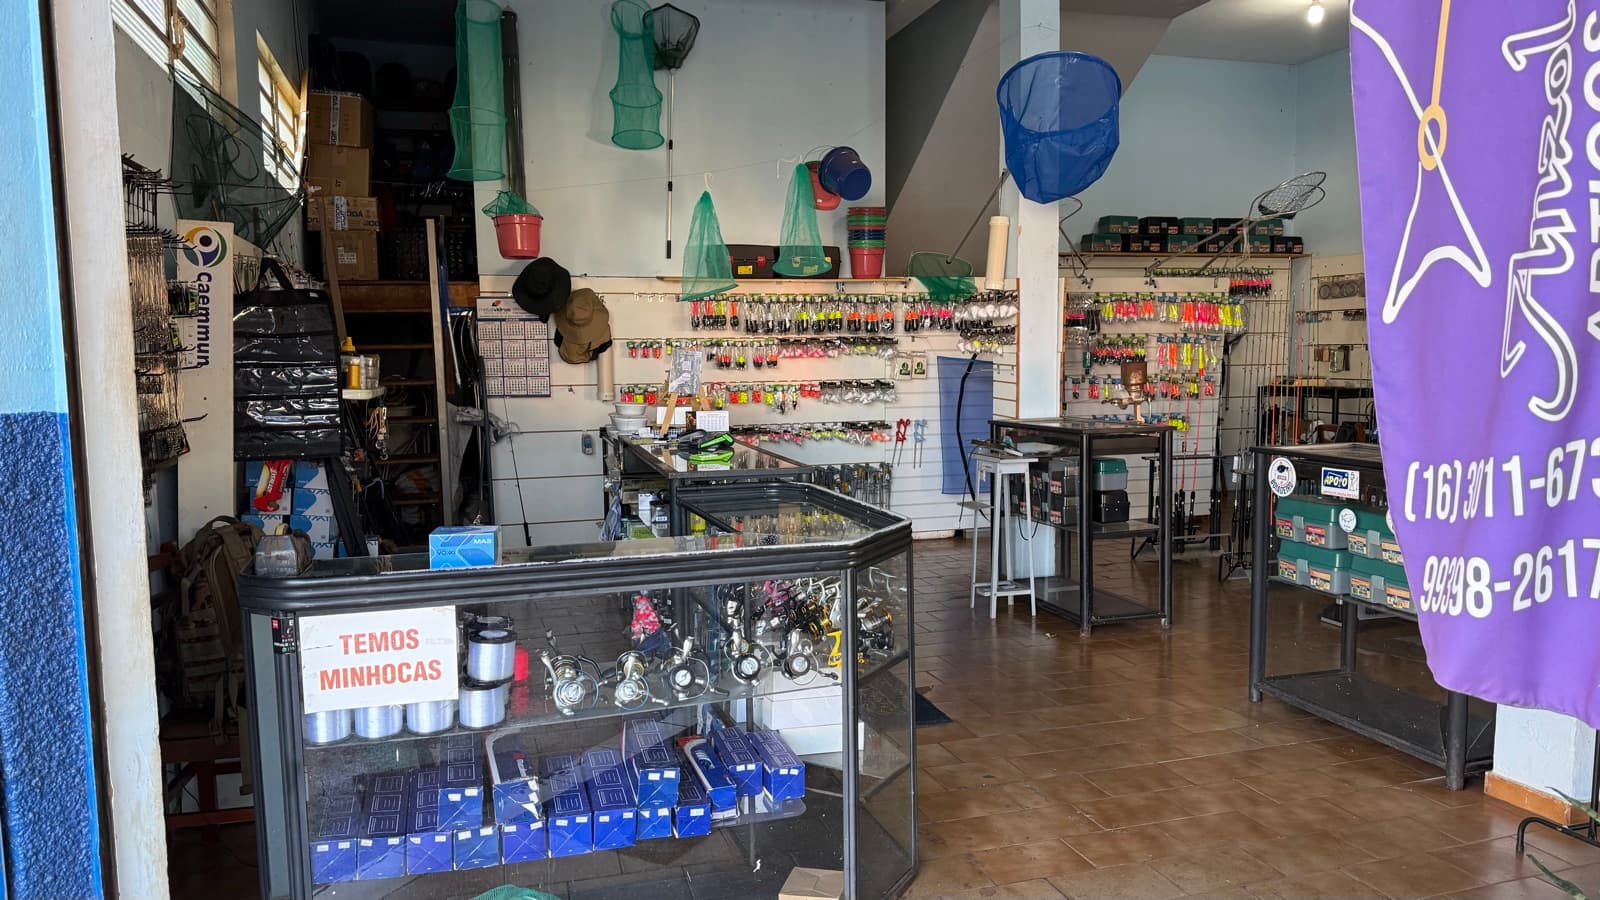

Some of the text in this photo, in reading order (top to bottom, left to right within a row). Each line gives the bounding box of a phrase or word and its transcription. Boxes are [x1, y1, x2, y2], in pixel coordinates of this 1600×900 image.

[196, 271, 213, 367] caemmun
[339, 628, 419, 655] TEMOS
[319, 659, 442, 691] MINHOCAS
